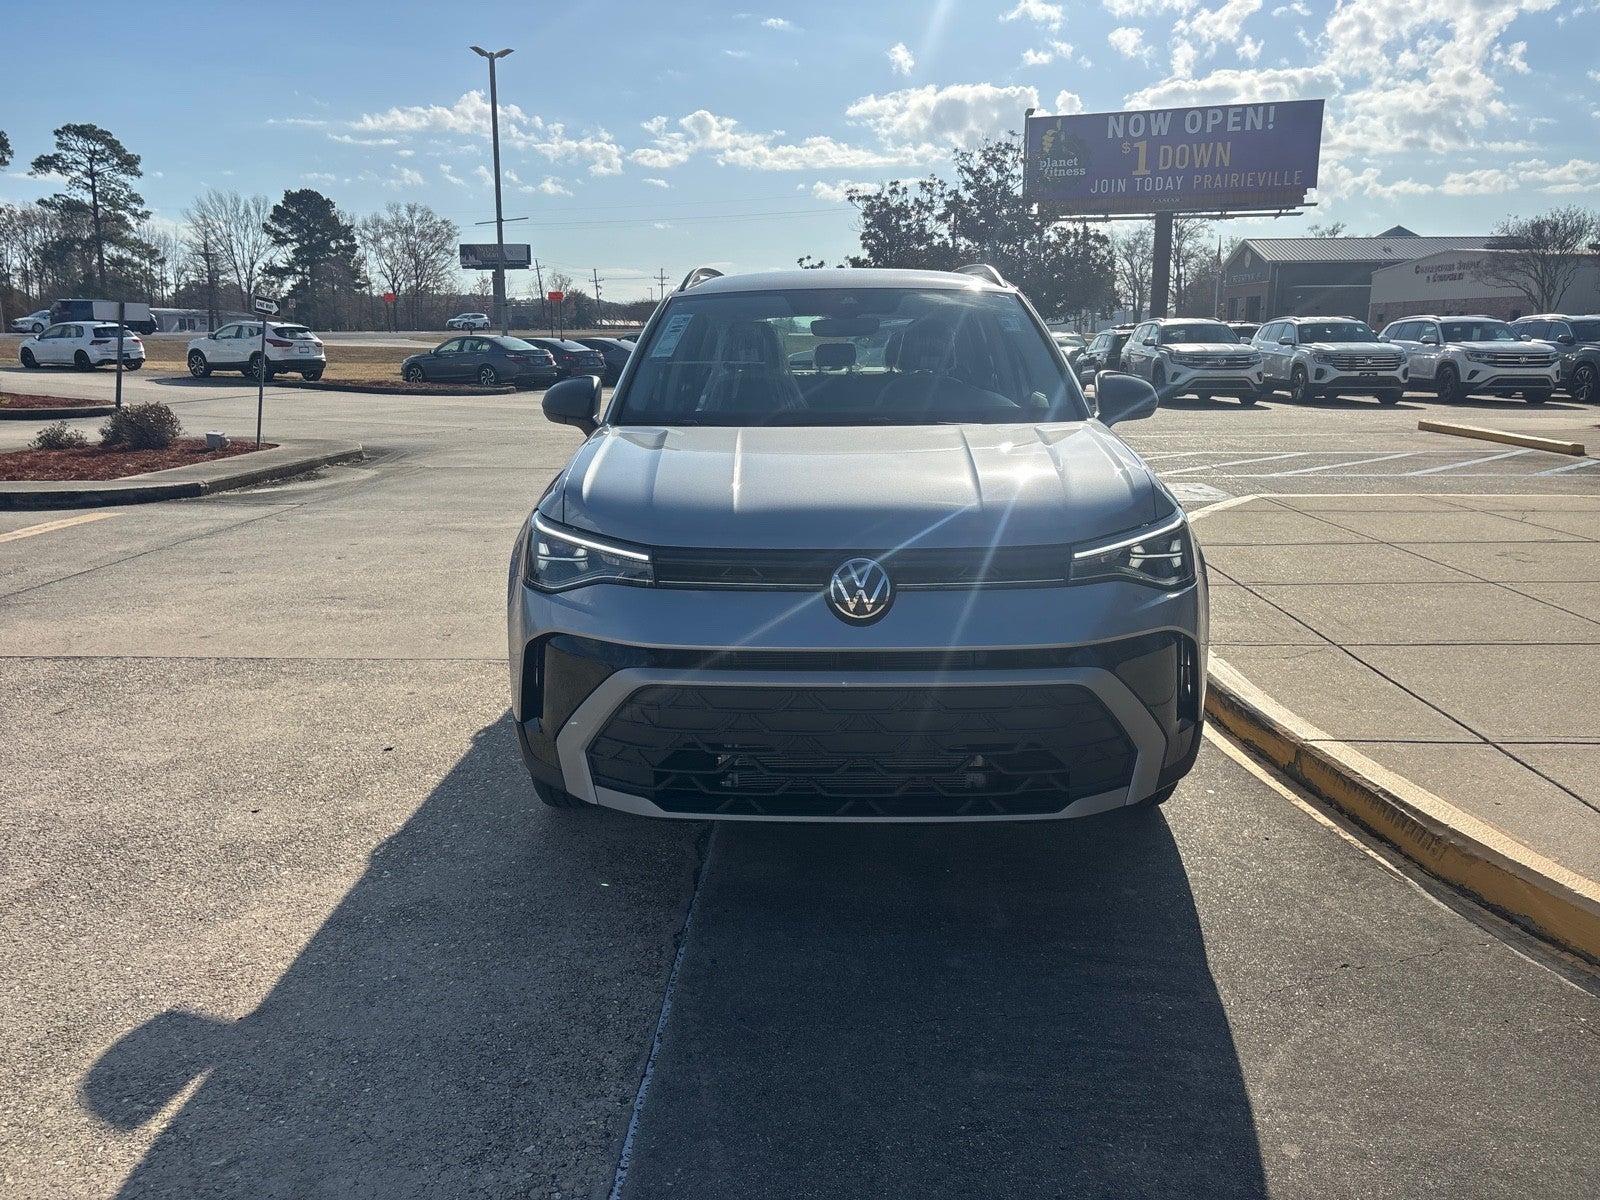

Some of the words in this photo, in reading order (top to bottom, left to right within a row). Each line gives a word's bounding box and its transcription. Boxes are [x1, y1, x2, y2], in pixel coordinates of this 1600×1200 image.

[1107, 112, 1172, 138] NOW
[1185, 106, 1276, 134] OPEN!
[1040, 157, 1079, 169] planet
[1121, 140, 1151, 176] $1
[1158, 142, 1232, 171] DOWN
[1042, 167, 1087, 178] fitness
[1090, 178, 1126, 194] JOIN
[1135, 176, 1184, 192] TODAY
[1193, 170, 1303, 190] PRAIRIEVILLE
[830, 558, 891, 619] VW
